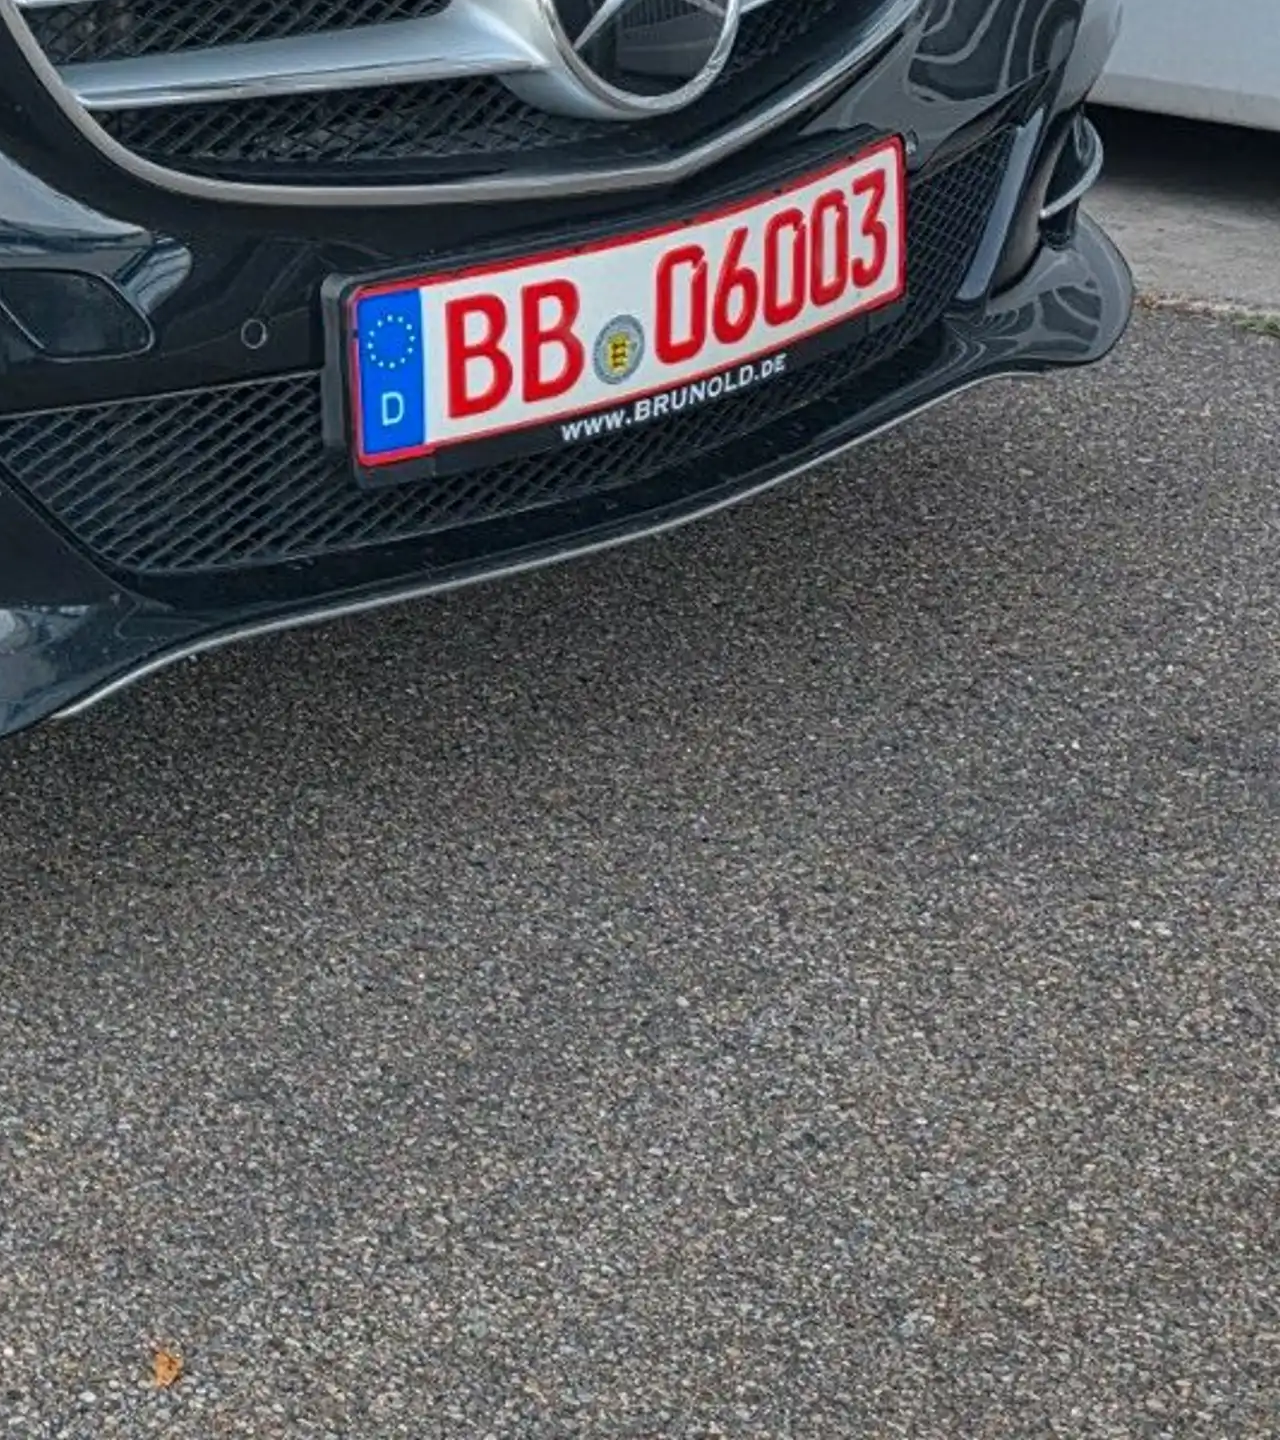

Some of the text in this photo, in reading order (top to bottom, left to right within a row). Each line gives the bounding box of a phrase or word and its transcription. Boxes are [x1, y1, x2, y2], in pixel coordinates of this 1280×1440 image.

[444, 168, 889, 420] BB 06003
[381, 391, 405, 427] D
[561, 353, 787, 441] WWW.BRUNOLD.DE
